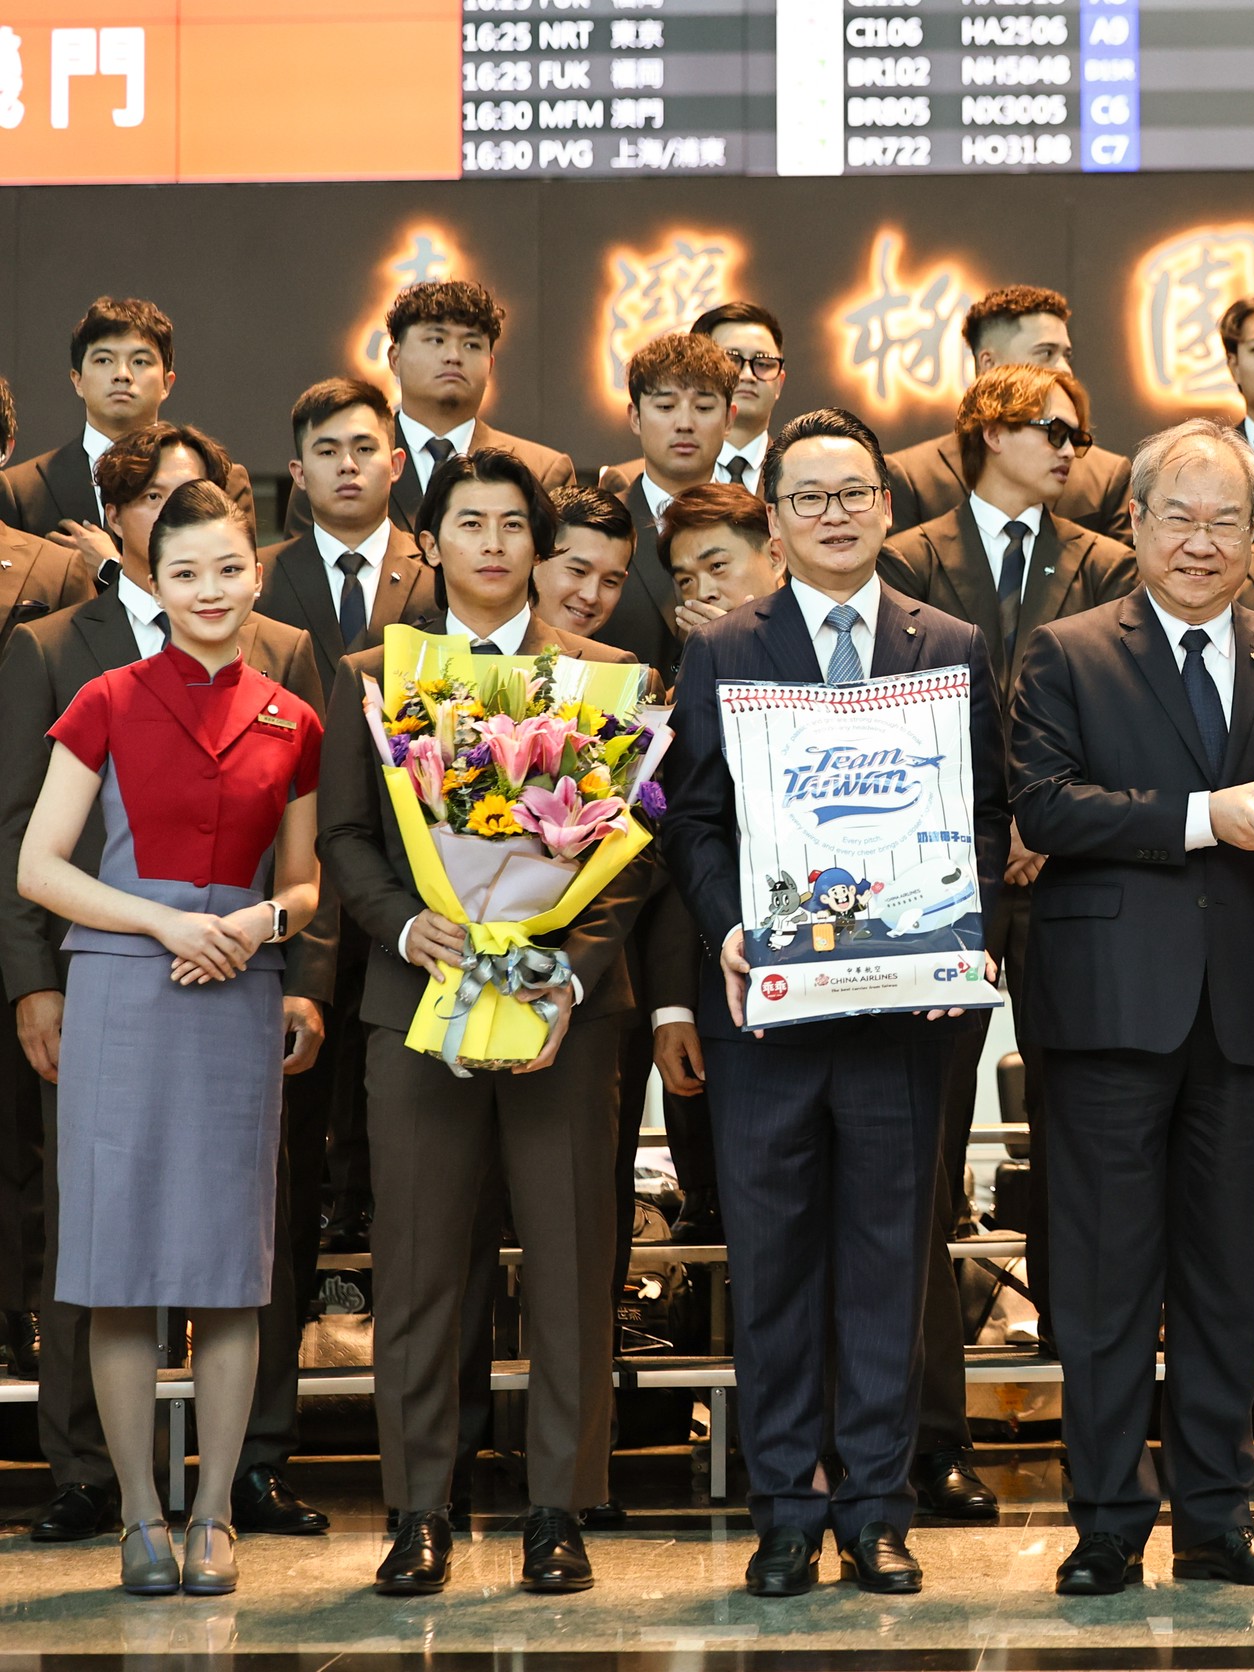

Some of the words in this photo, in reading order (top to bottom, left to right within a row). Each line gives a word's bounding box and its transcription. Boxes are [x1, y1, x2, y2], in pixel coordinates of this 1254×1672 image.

[463, 22, 532, 51] 16:25
[539, 20, 594, 49] NRT
[463, 61, 532, 91] 16:25
[539, 59, 591, 89] FUK
[848, 56, 931, 87] BR102
[463, 100, 533, 131] 16:30
[539, 99, 604, 129] MFM
[1090, 94, 1130, 125] C6
[463, 140, 533, 170] 16:30
[539, 139, 594, 169] PVG
[848, 135, 931, 166] BR722
[1090, 134, 1130, 165] C7
[805, 746, 906, 774] Team
[782, 765, 912, 808] Taiwan
[842, 836, 861, 846] Every
[830, 975, 858, 985] CHINA
[859, 973, 899, 983] AIRLINES
[846, 965, 881, 975] 中華航空
[762, 979, 787, 995] 乖乖
